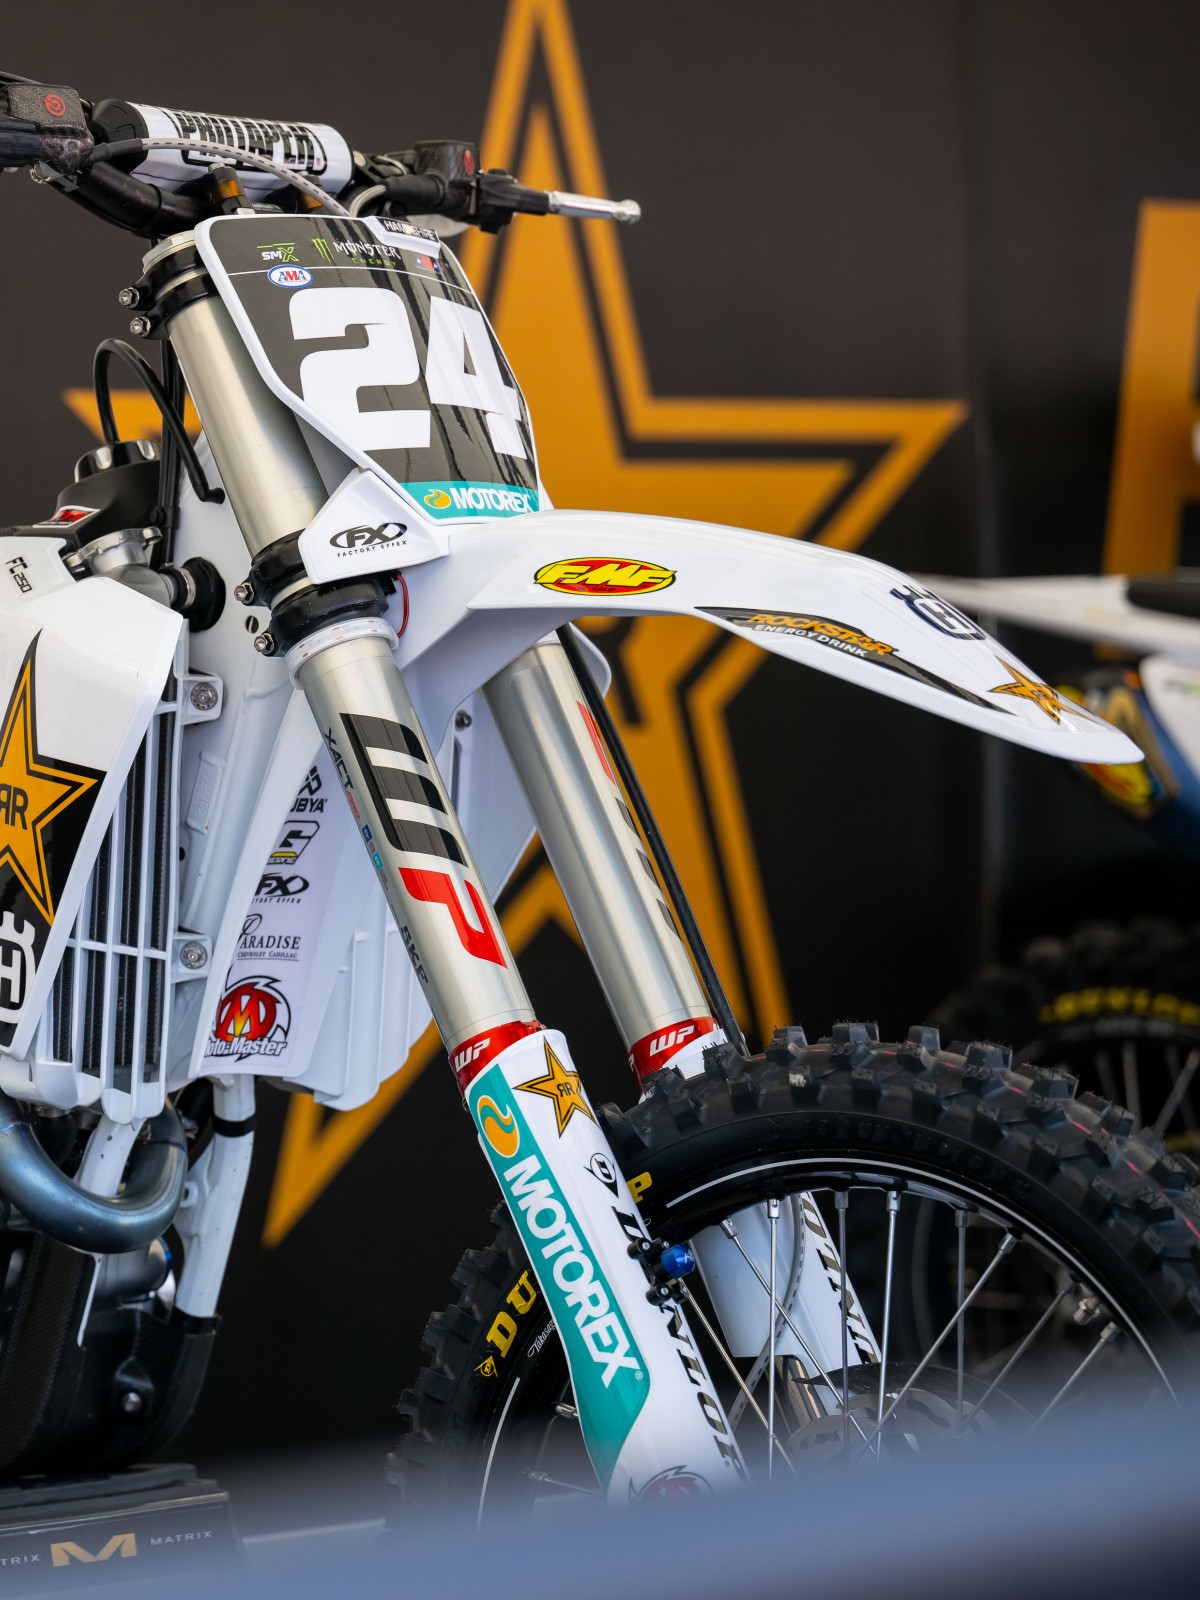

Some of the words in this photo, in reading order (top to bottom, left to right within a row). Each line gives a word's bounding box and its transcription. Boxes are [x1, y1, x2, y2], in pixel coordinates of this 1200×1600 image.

[332, 240, 402, 260] MONSTER
[352, 257, 396, 267] ENERGY
[278, 270, 307, 282] AMA
[288, 287, 529, 460] 24
[453, 486, 535, 514] MOTOREX
[336, 544, 376, 558] FACTORY
[380, 539, 408, 550] EFFEX
[534, 562, 678, 588] FMF
[746, 613, 893, 656] ROCKSTAR
[754, 624, 818, 639] ENERGY
[816, 634, 869, 658] DRINK
[454, 1037, 491, 1073] WP
[649, 1025, 694, 1057] WP
[503, 1153, 642, 1389] MOTOREX
[149, 1529, 214, 1547] MATRIX
